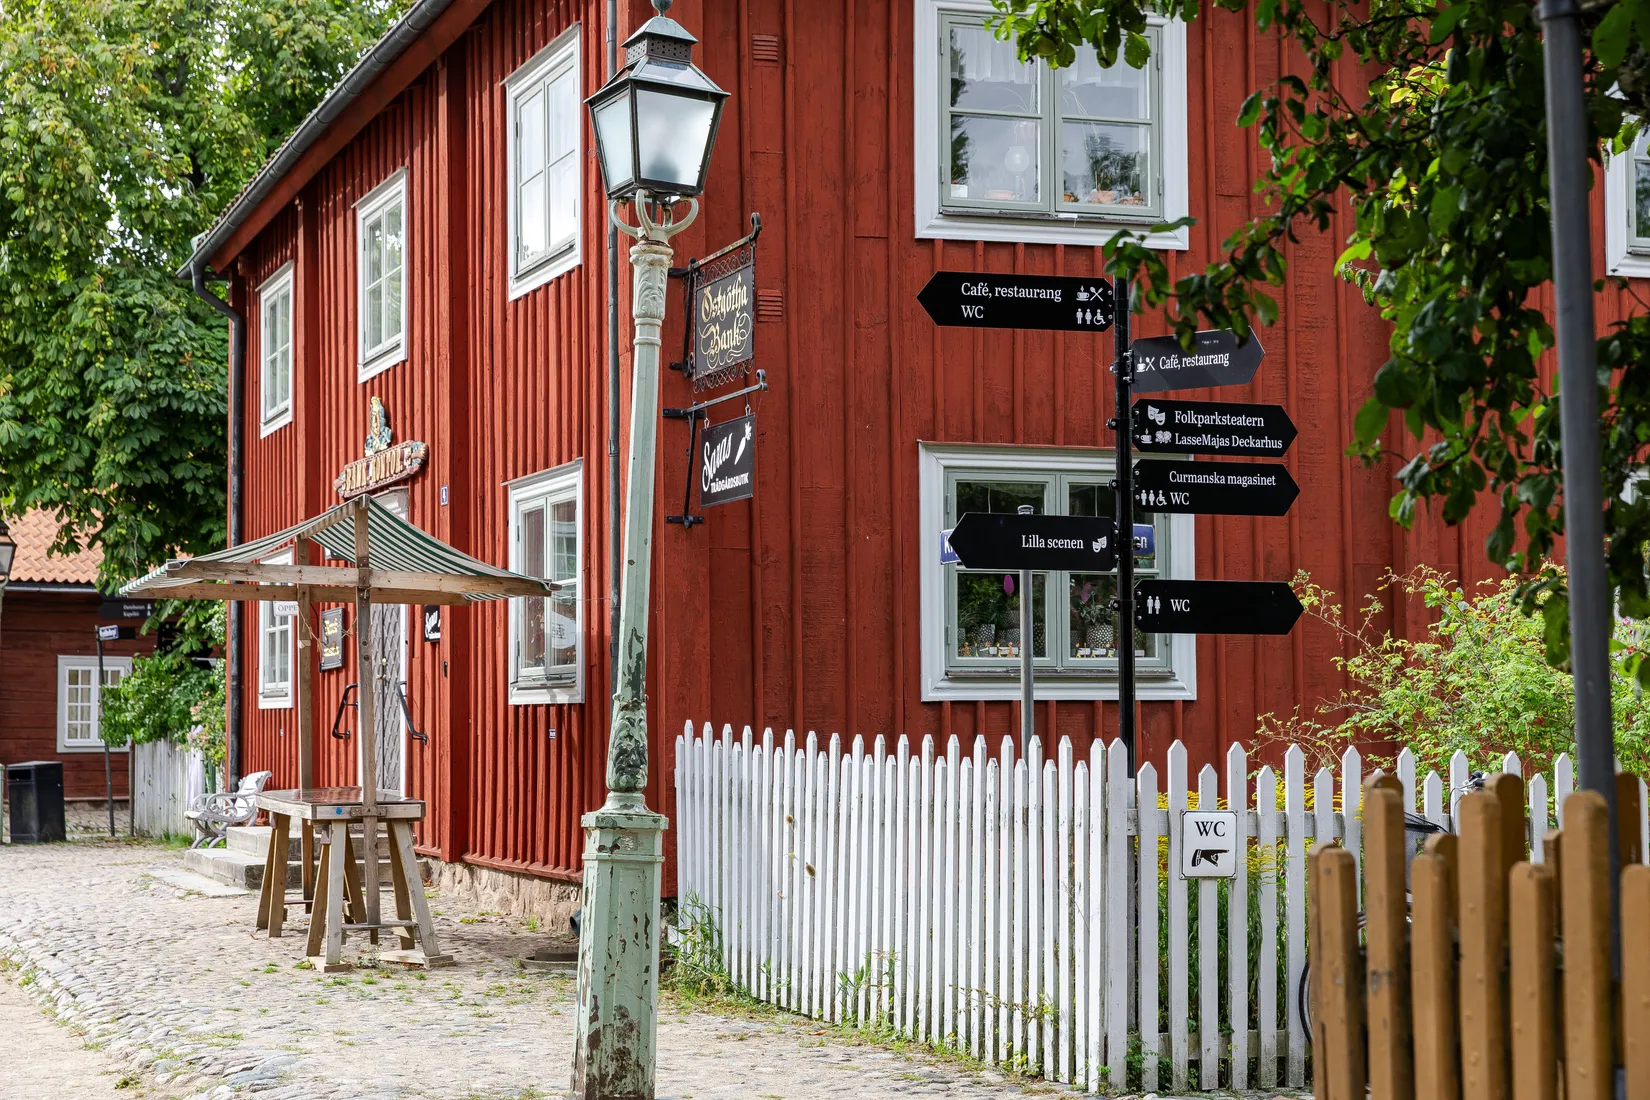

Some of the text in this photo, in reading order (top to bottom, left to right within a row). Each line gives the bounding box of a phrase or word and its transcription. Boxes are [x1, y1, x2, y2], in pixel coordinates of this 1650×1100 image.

[701, 272, 748, 323] Östgötha
[961, 282, 1062, 302] Café, restaurang
[961, 305, 984, 319] WC
[702, 314, 745, 357] Bank
[1159, 352, 1230, 370] Café, restaurang
[1175, 410, 1265, 427] Folkparksteatern
[1175, 433, 1283, 449] LasseMajas Deckarhus
[702, 432, 733, 492] Saras
[710, 471, 749, 494] TRÄDGÅRDSBUTIK
[1169, 470, 1276, 488] Curmanska magasinet
[1169, 492, 1190, 505] WC
[1022, 534, 1084, 549] Lilla scenen
[1170, 599, 1190, 612] WC
[1194, 820, 1226, 837] WC
